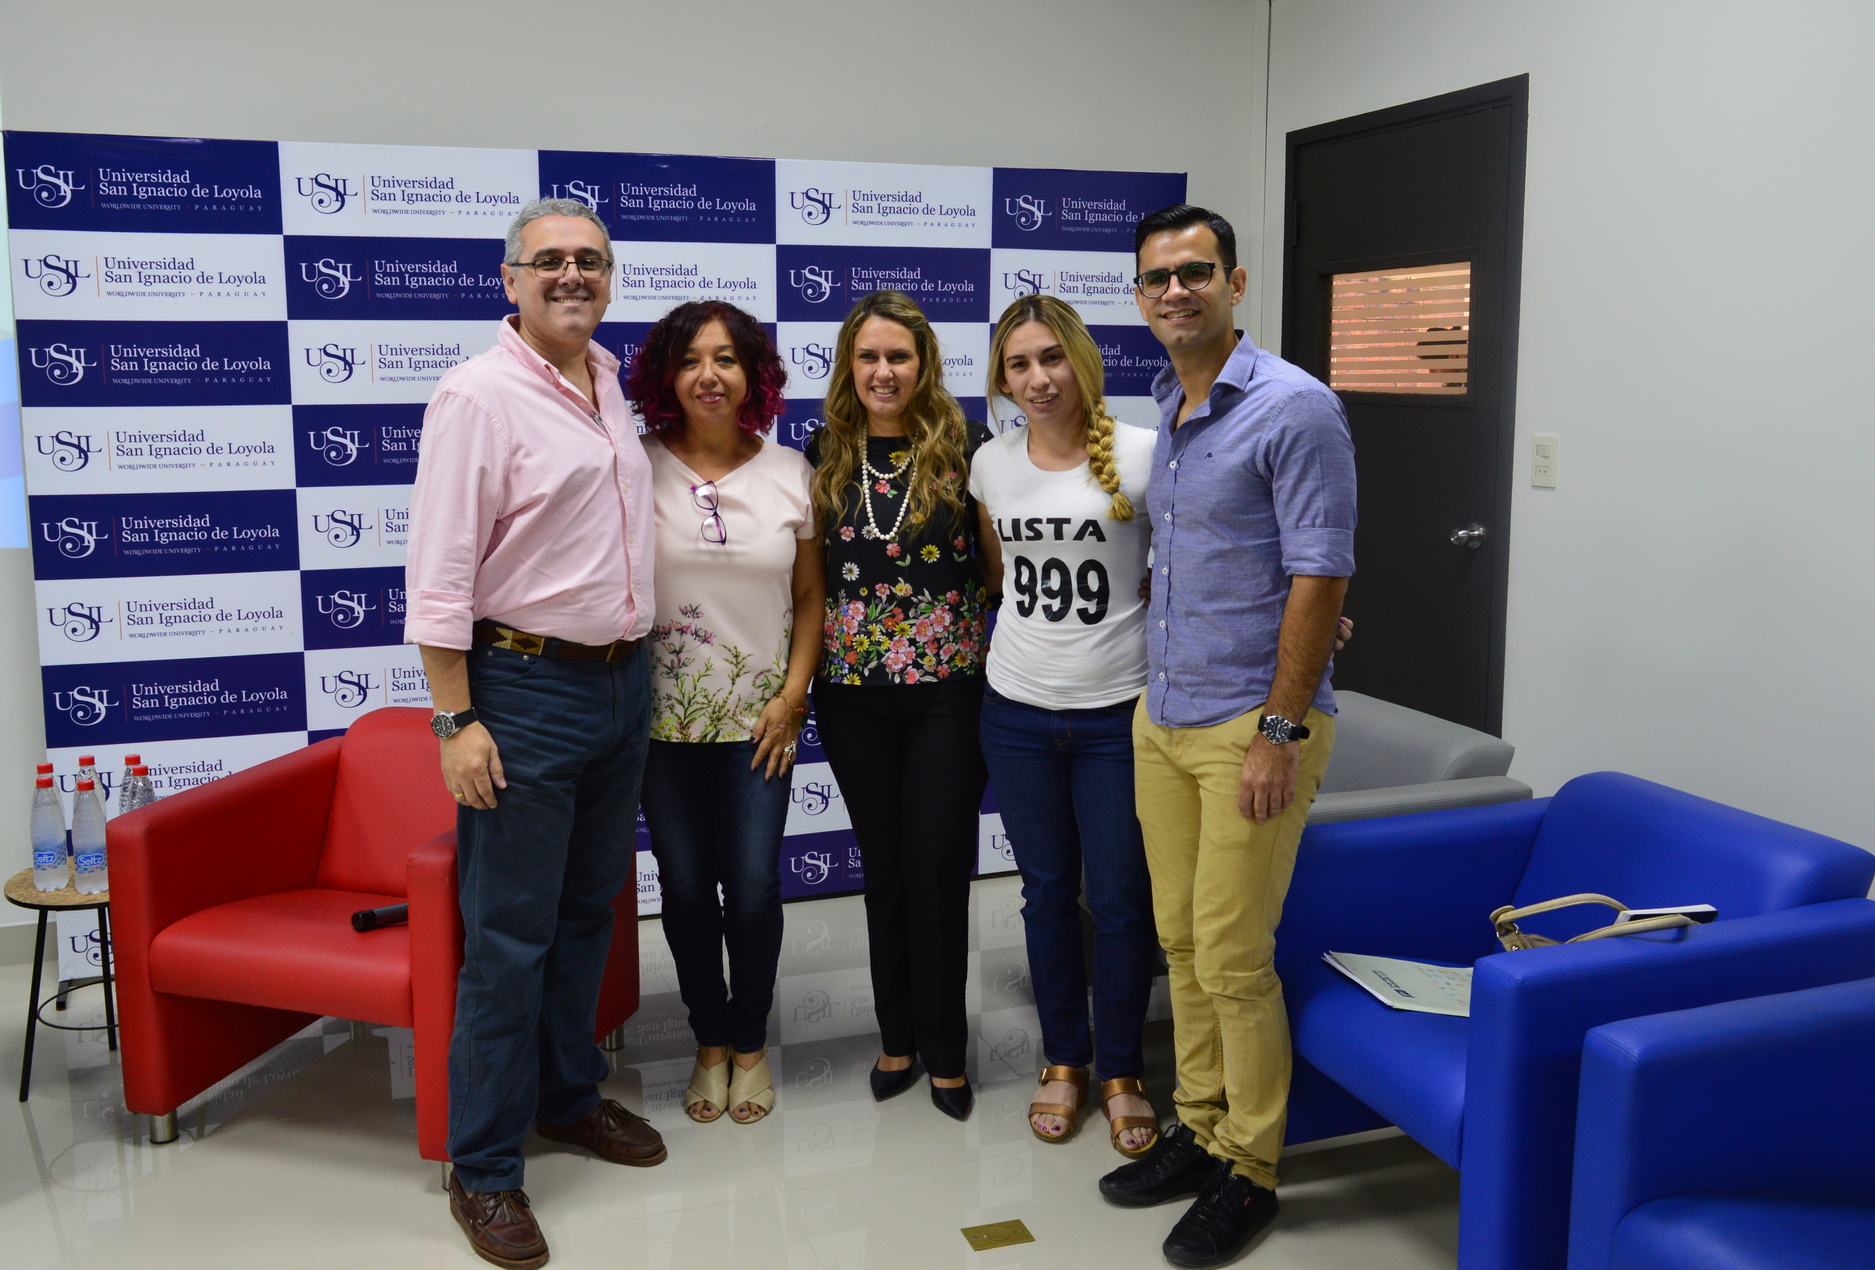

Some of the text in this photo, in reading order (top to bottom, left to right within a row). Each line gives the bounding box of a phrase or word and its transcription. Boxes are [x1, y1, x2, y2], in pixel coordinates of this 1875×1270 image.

[99, 168, 190, 183] Universidad
[371, 176, 454, 189] Universidad
[16, 164, 85, 208] USIL
[99, 182, 262, 201] San Ignacio de Loyola
[295, 173, 358, 214] USIL
[620, 183, 697, 196] Universidad
[371, 189, 520, 207] San Ignacio de Loyola
[620, 196, 756, 213] San Ignacio de Loyola
[852, 190, 922, 203] Universidad
[1062, 198, 1126, 209] Universidad
[789, 188, 841, 226] USIL
[852, 202, 976, 219] San Ignacio de Loyola
[1005, 194, 1052, 231] USIL
[1061, 209, 1081, 220] San
[1084, 210, 1123, 223] Ignacio
[1125, 211, 1138, 223] de
[104, 257, 195, 270] Universidad
[374, 260, 457, 273] Universidad
[622, 264, 698, 276] Universidad
[22, 254, 91, 297] USIL
[105, 271, 266, 287] San Ignacio de Loyola
[299, 258, 362, 300] USIL
[375, 273, 474, 289] San Ignacio de
[852, 267, 921, 279] Universidad
[1060, 271, 1123, 283] Universidad
[622, 277, 757, 292] San Ignacio de Loyola
[789, 265, 841, 303] USIL
[851, 279, 872, 290] San
[921, 279, 934, 291] de
[938, 280, 974, 294] Loyola
[1059, 283, 1079, 293] San
[1082, 283, 1120, 296] Ignacio
[110, 344, 200, 357] Universidad
[378, 343, 461, 356] Universidad
[29, 343, 97, 386] USIL
[111, 357, 271, 374] San Ignacio de Loyola
[304, 343, 366, 384] USIL
[378, 358, 458, 372] San Ignacio
[1120, 356, 1133, 367] de
[1135, 356, 1168, 370] Loyola
[116, 429, 205, 443] Universidad
[34, 430, 102, 472] USIL
[116, 442, 275, 459] San Ignacio de Loyola
[308, 426, 370, 466] USIL
[381, 439, 408, 451] San
[121, 514, 210, 529] Universidad
[312, 509, 373, 548] USIL
[997, 517, 1107, 542] LISTA
[41, 517, 108, 559] USIL
[122, 526, 280, 544] San Ignacio de Loyola
[214, 544, 279, 552] PARAGUAY
[1014, 555, 1110, 625] 999
[126, 597, 214, 613] Universidad
[316, 590, 376, 629] USIL
[47, 602, 113, 642] USIL
[127, 608, 283, 627] San Ignacio de Loyola
[219, 625, 284, 634] PARAGUAY
[132, 679, 219, 696] Universidad
[320, 670, 379, 708] USIL
[391, 680, 416, 692] San
[53, 686, 119, 726] USIL
[133, 688, 288, 709] San Ignacio de Loyola
[392, 696, 429, 704] WORLDWIDE
[223, 706, 287, 715] PARAGUAY
[79, 854, 102, 866] Seltz
[790, 851, 839, 885] USIL
